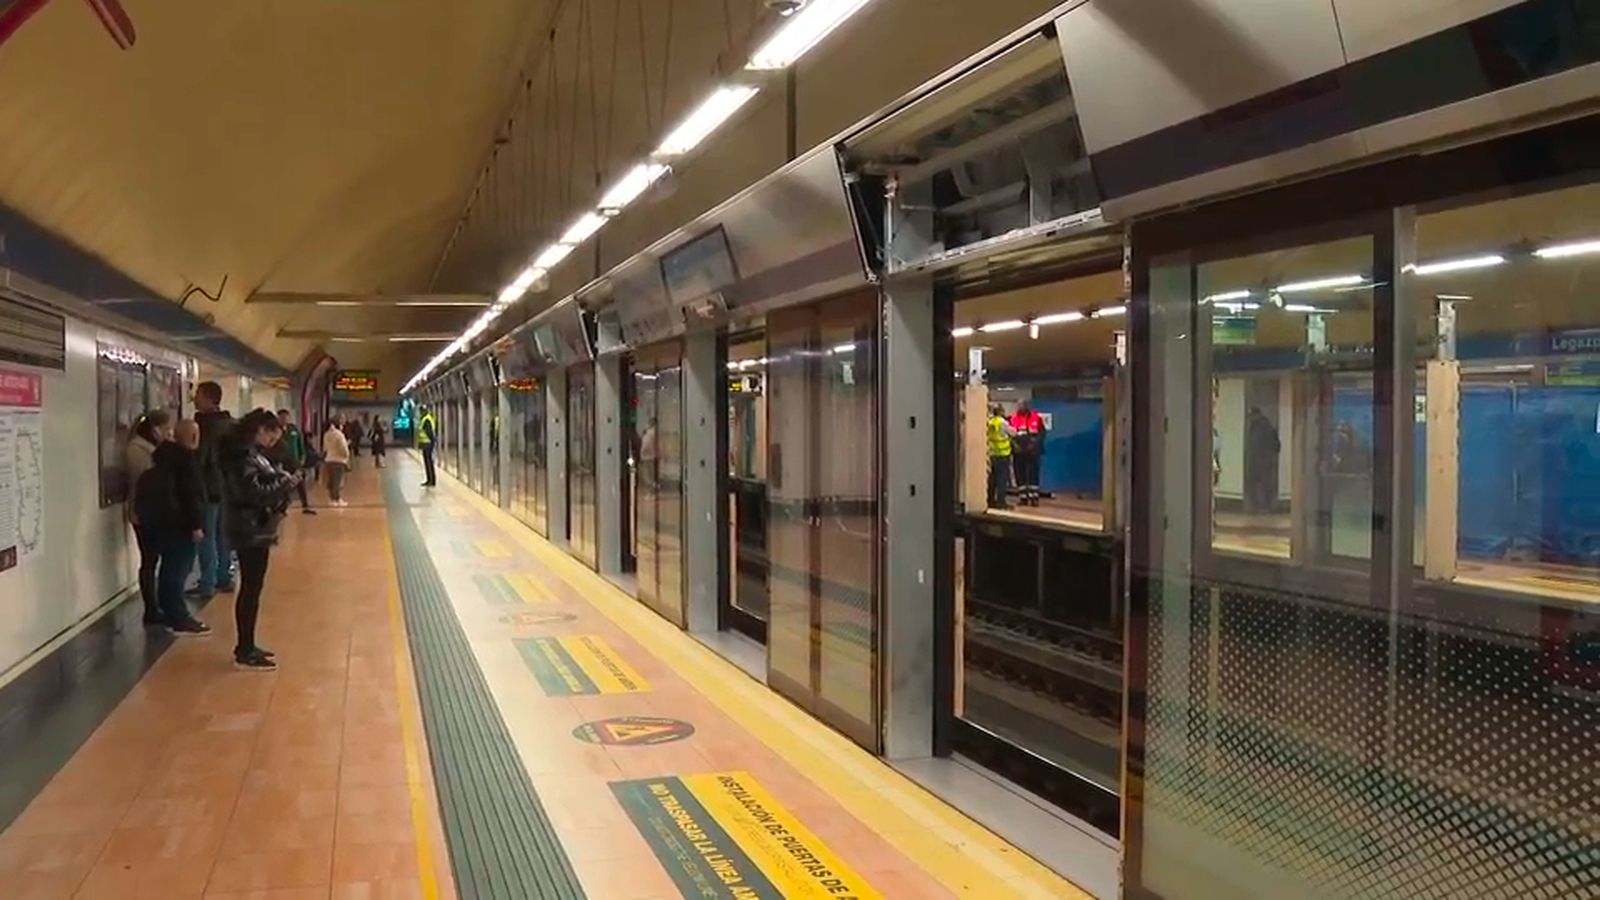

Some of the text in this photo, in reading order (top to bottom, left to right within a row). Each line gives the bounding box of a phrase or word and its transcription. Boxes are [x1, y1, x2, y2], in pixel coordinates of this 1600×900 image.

[648, 783, 670, 796] NO
[658, 794, 708, 841] TRASPASAR
[693, 841, 718, 855] LA
[717, 775, 850, 894] INSTALACIÓN DE PUERTAS DE
[703, 854, 743, 884] LÍNEA
